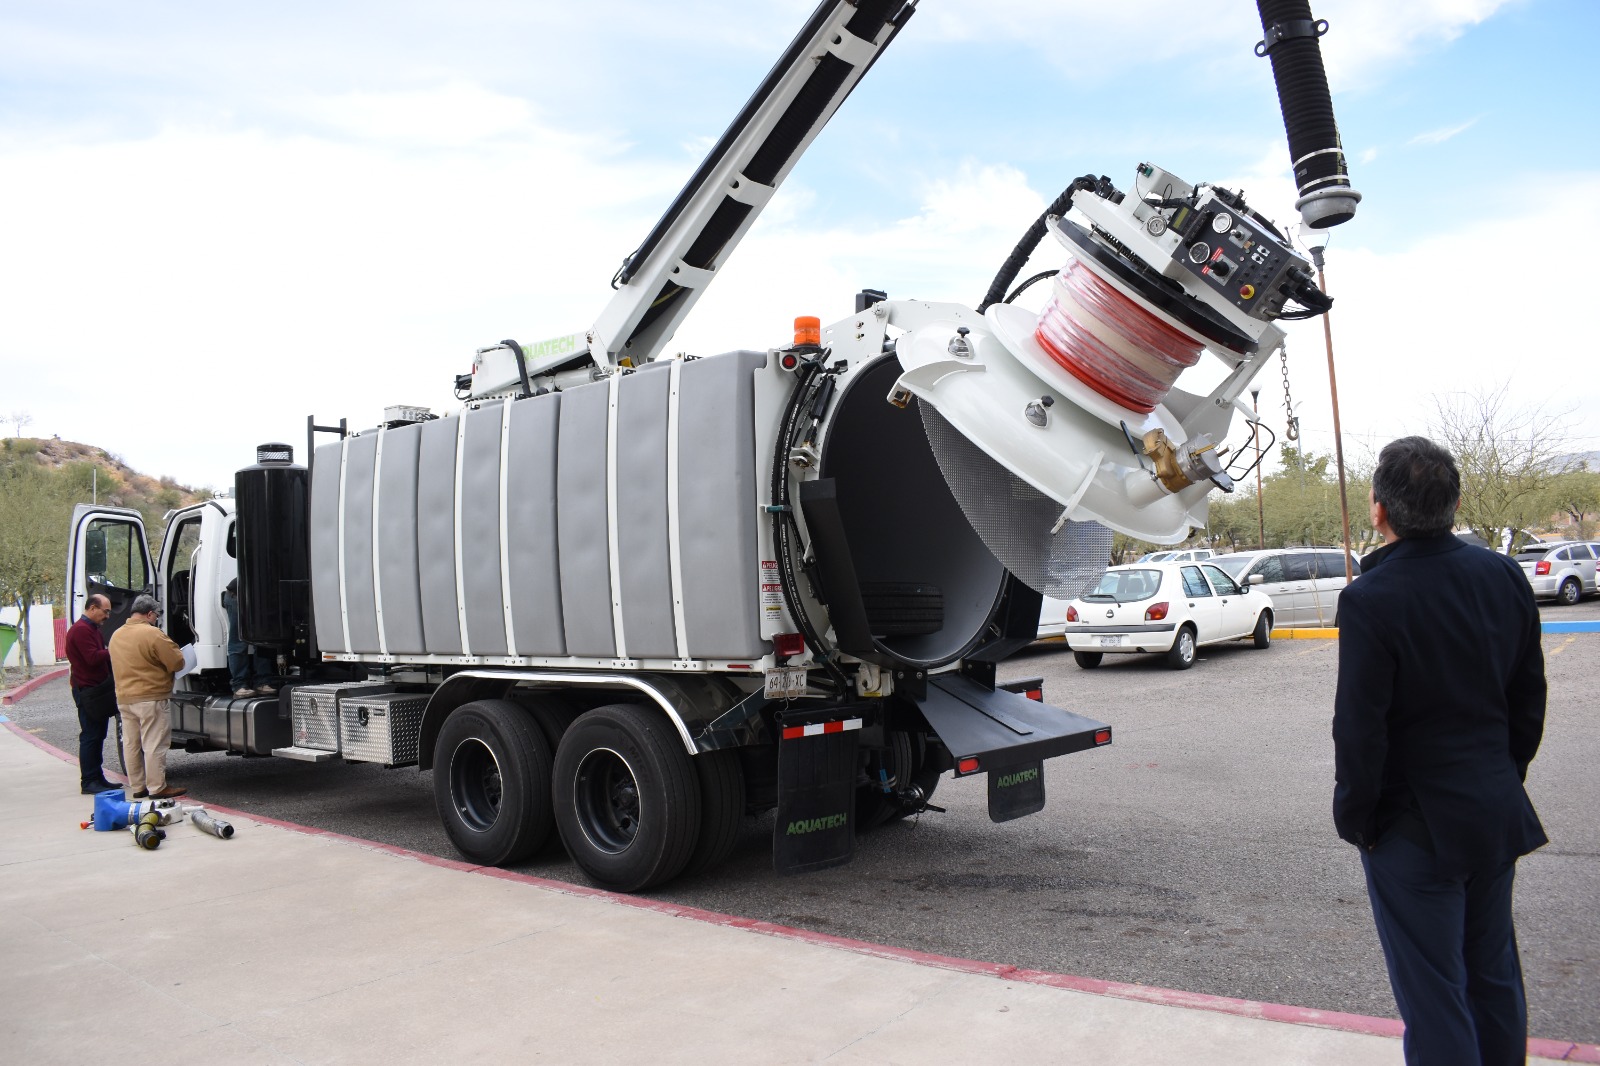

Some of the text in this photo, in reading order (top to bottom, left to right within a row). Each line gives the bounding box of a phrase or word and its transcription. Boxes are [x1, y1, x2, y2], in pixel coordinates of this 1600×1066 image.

[513, 335, 576, 362] QUATECH
[996, 767, 1038, 789] AQUATECH
[785, 812, 847, 836] AQUATECH
